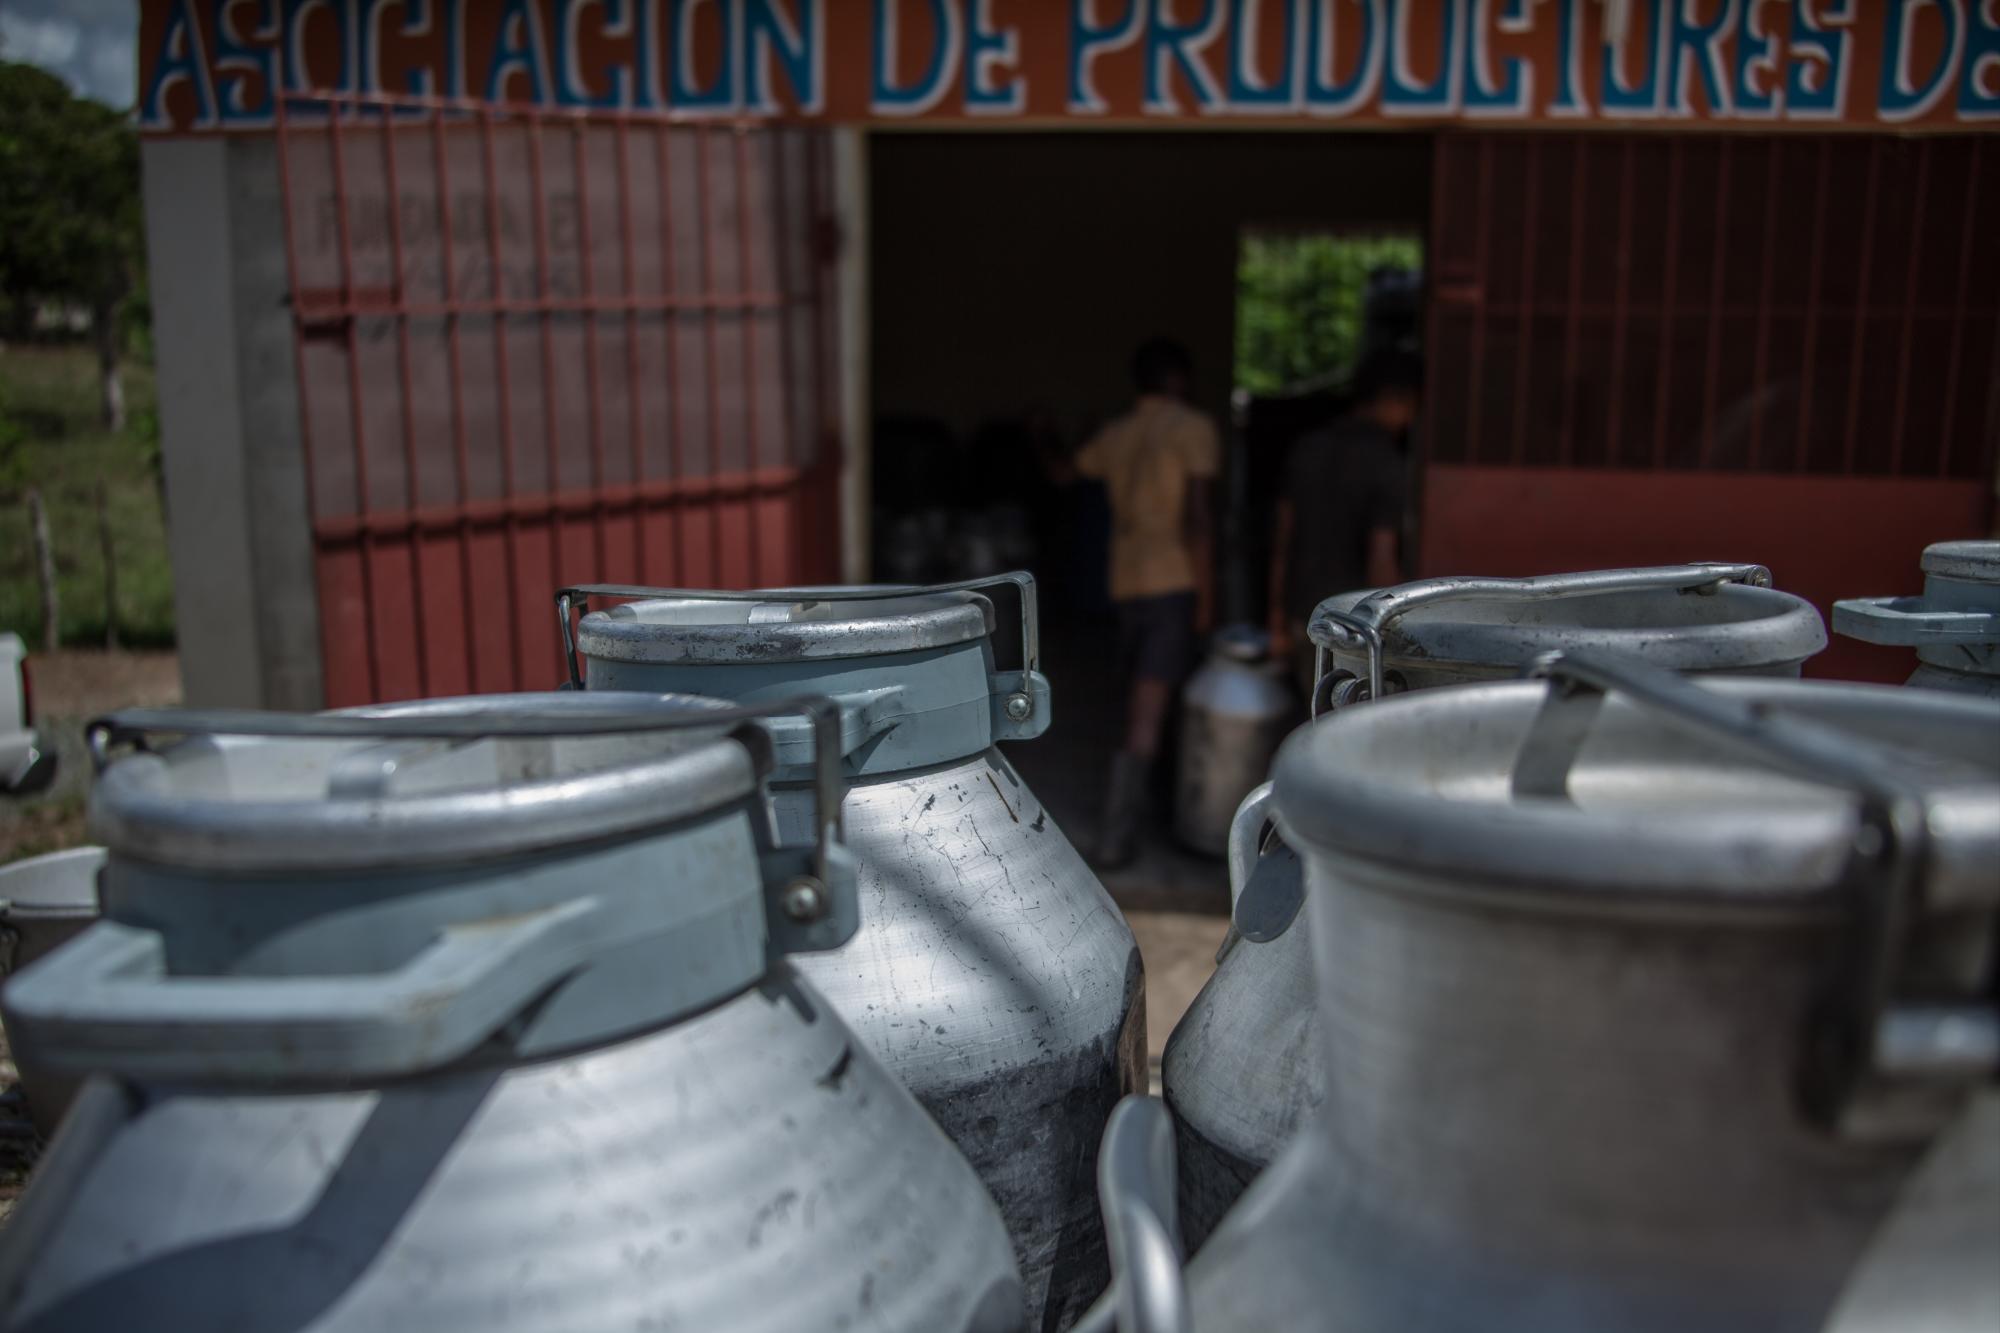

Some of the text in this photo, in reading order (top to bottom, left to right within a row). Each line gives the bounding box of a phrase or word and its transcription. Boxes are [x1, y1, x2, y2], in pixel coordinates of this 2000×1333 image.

[140, 0, 826, 128] ASOCIACION
[868, 0, 1028, 116] DE
[1066, 0, 1856, 119] PRODUCTORES
